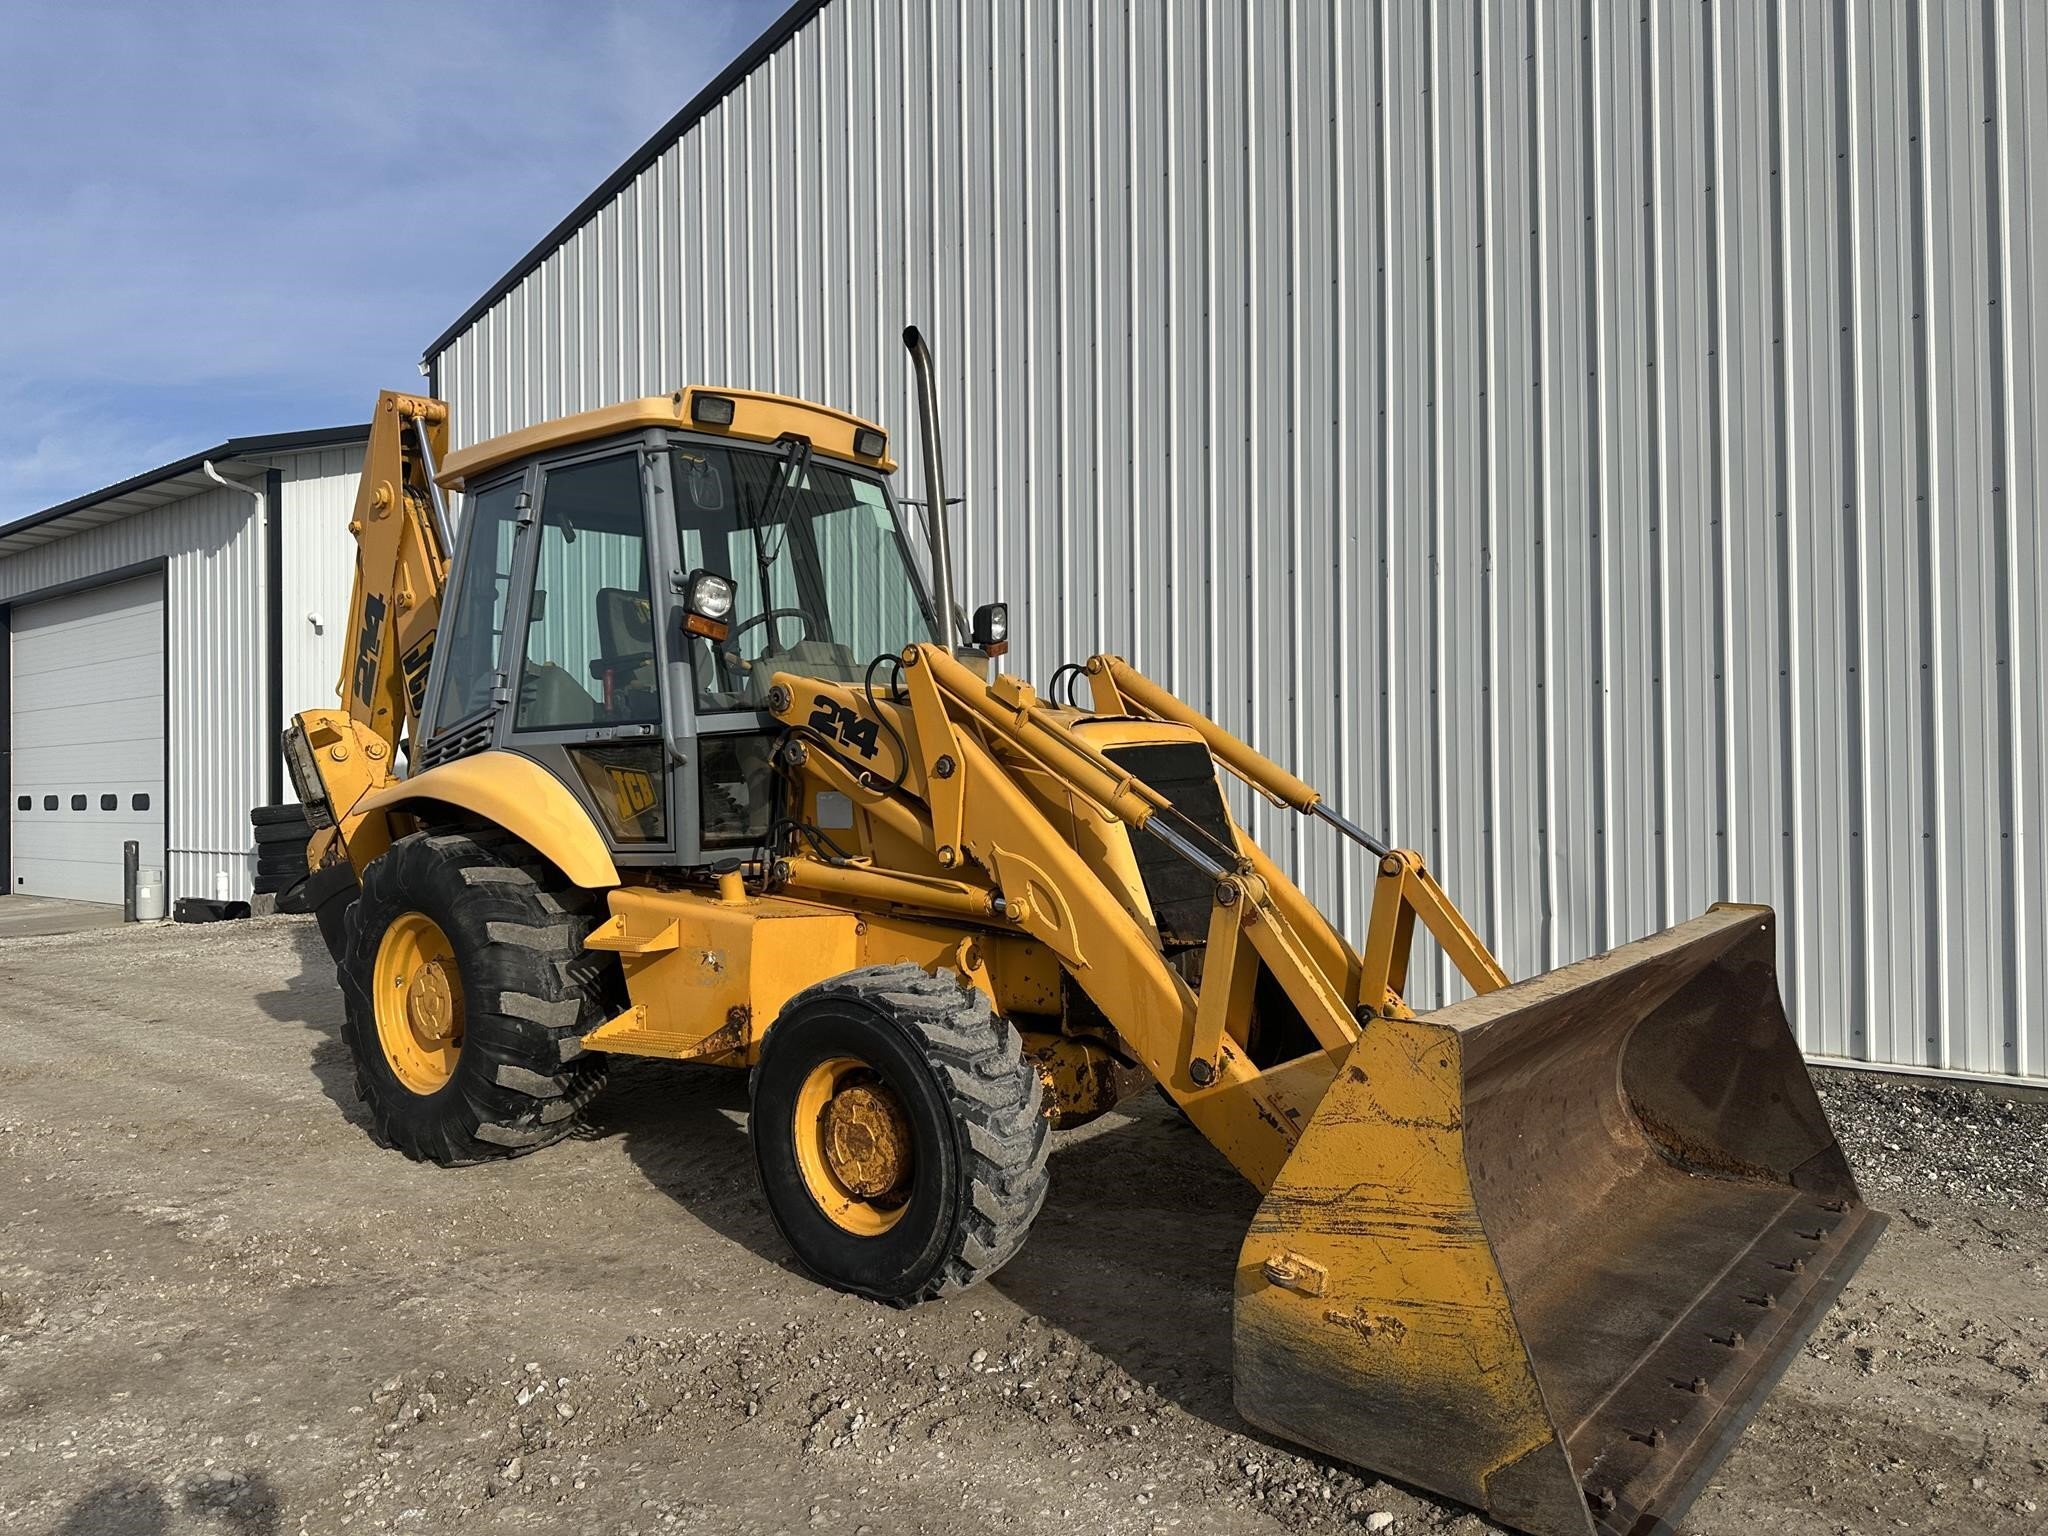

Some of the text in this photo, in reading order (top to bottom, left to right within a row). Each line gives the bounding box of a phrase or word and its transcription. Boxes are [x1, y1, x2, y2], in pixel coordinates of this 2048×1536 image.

[353, 592, 386, 708] 214
[808, 694, 880, 760] 214
[610, 770, 654, 818] JCB
